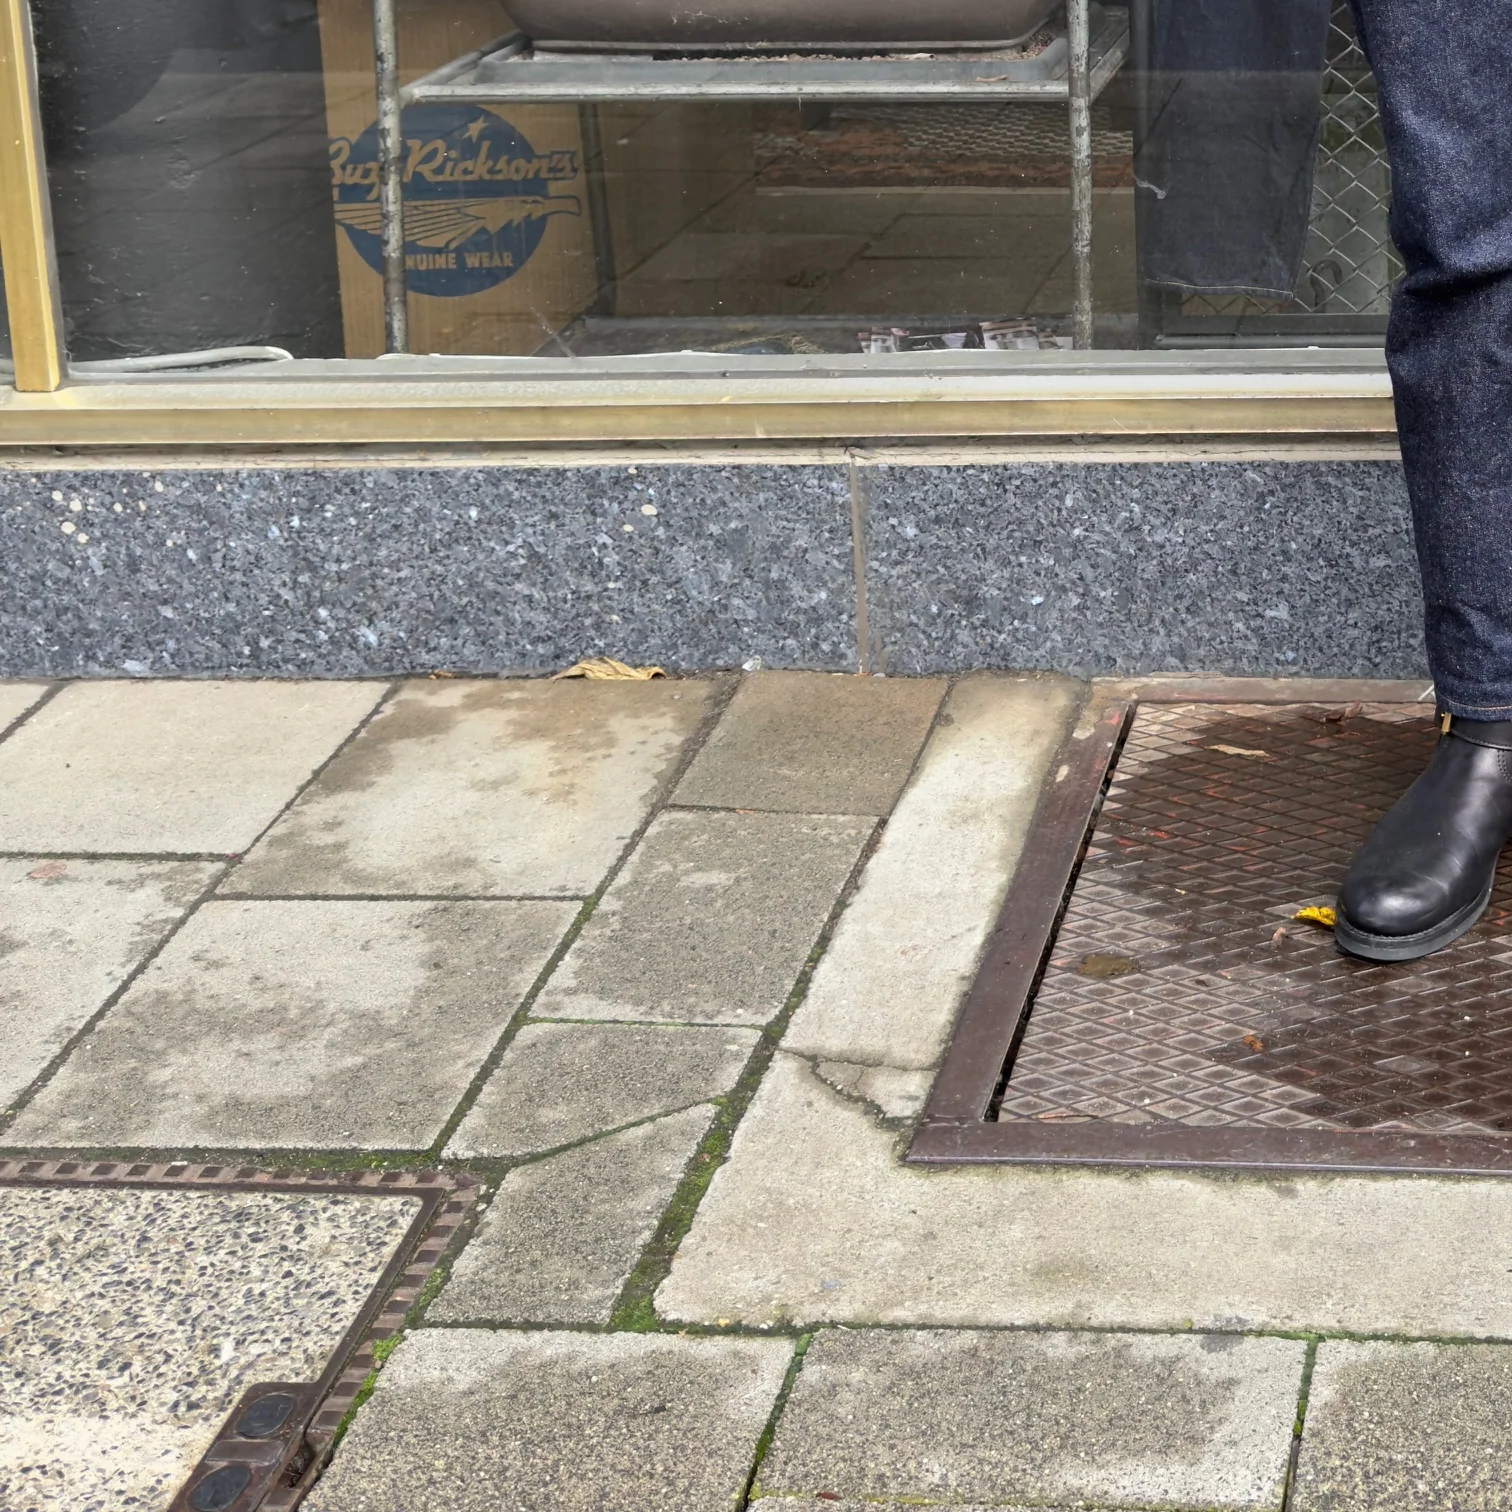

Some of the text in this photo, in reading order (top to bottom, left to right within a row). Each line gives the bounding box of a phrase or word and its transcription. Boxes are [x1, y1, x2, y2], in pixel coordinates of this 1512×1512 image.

[328, 139, 381, 201] Buz
[405, 251, 514, 270] NUINE WEAR
